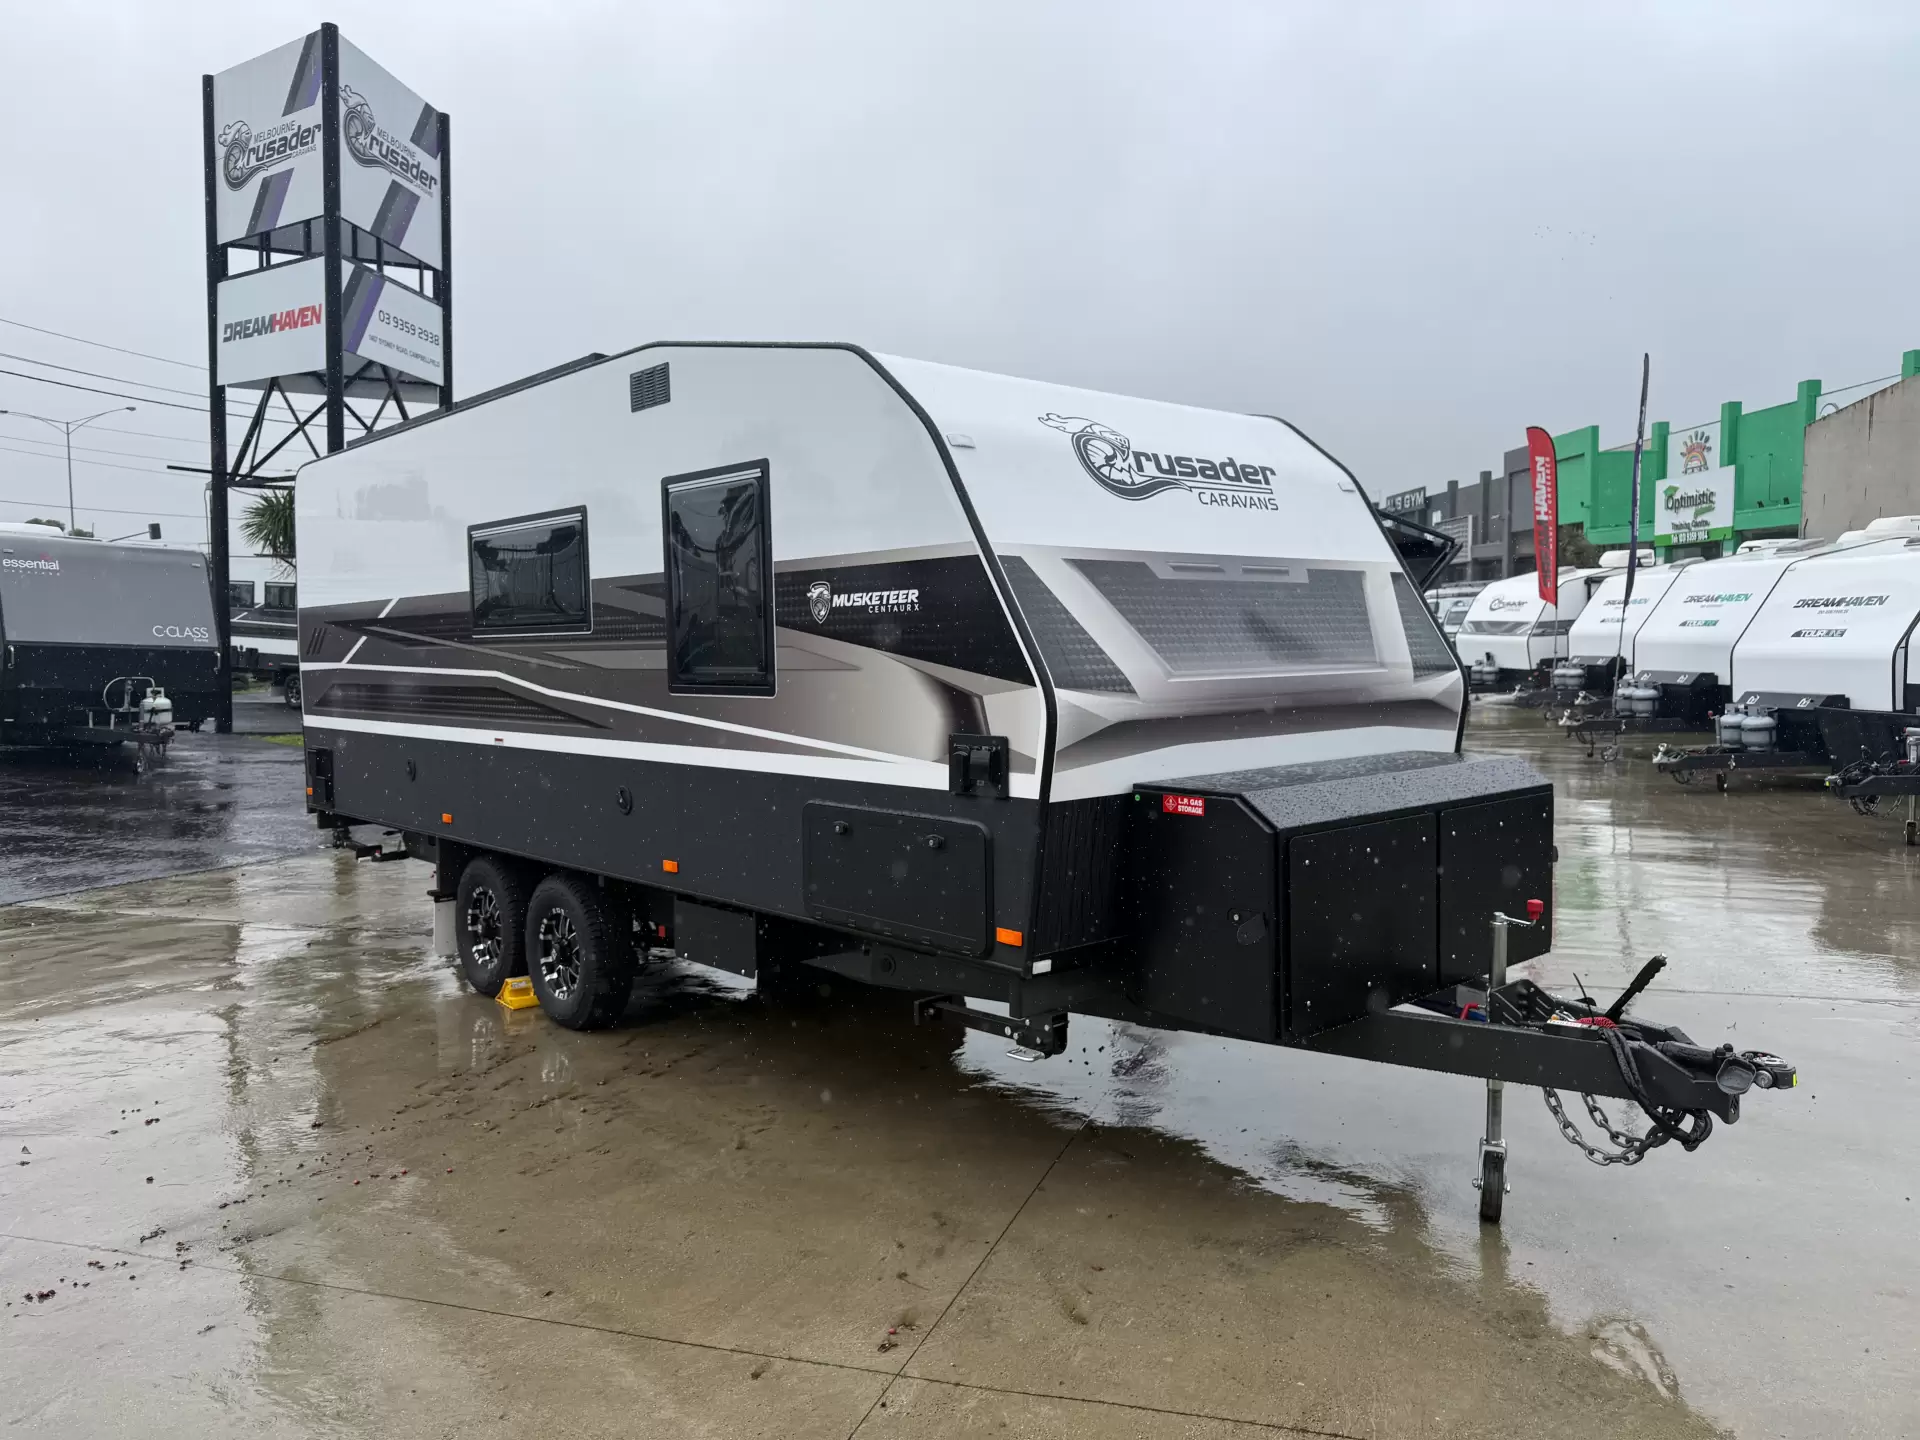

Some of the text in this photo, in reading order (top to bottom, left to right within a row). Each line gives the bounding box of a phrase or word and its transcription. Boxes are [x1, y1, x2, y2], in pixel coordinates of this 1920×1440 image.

[253, 120, 296, 144] MELBOURNE
[376, 127, 417, 161] MELBOURNE
[222, 303, 323, 343] DREAMHAVEN
[378, 309, 440, 346] 03 9359 2938
[1198, 491, 1279, 511] CARAVANS
[1403, 490, 1424, 509] GYM
[1665, 488, 1716, 514] Optimistic
[3, 558, 60, 570] essential
[832, 589, 919, 608] MUSKETEER
[1683, 593, 1753, 603] DREAMHAVEN
[1793, 595, 1890, 608] DREAMHAVEN
[1177, 805, 1203, 814] STORAGE
[1190, 798, 1202, 806] GAS
